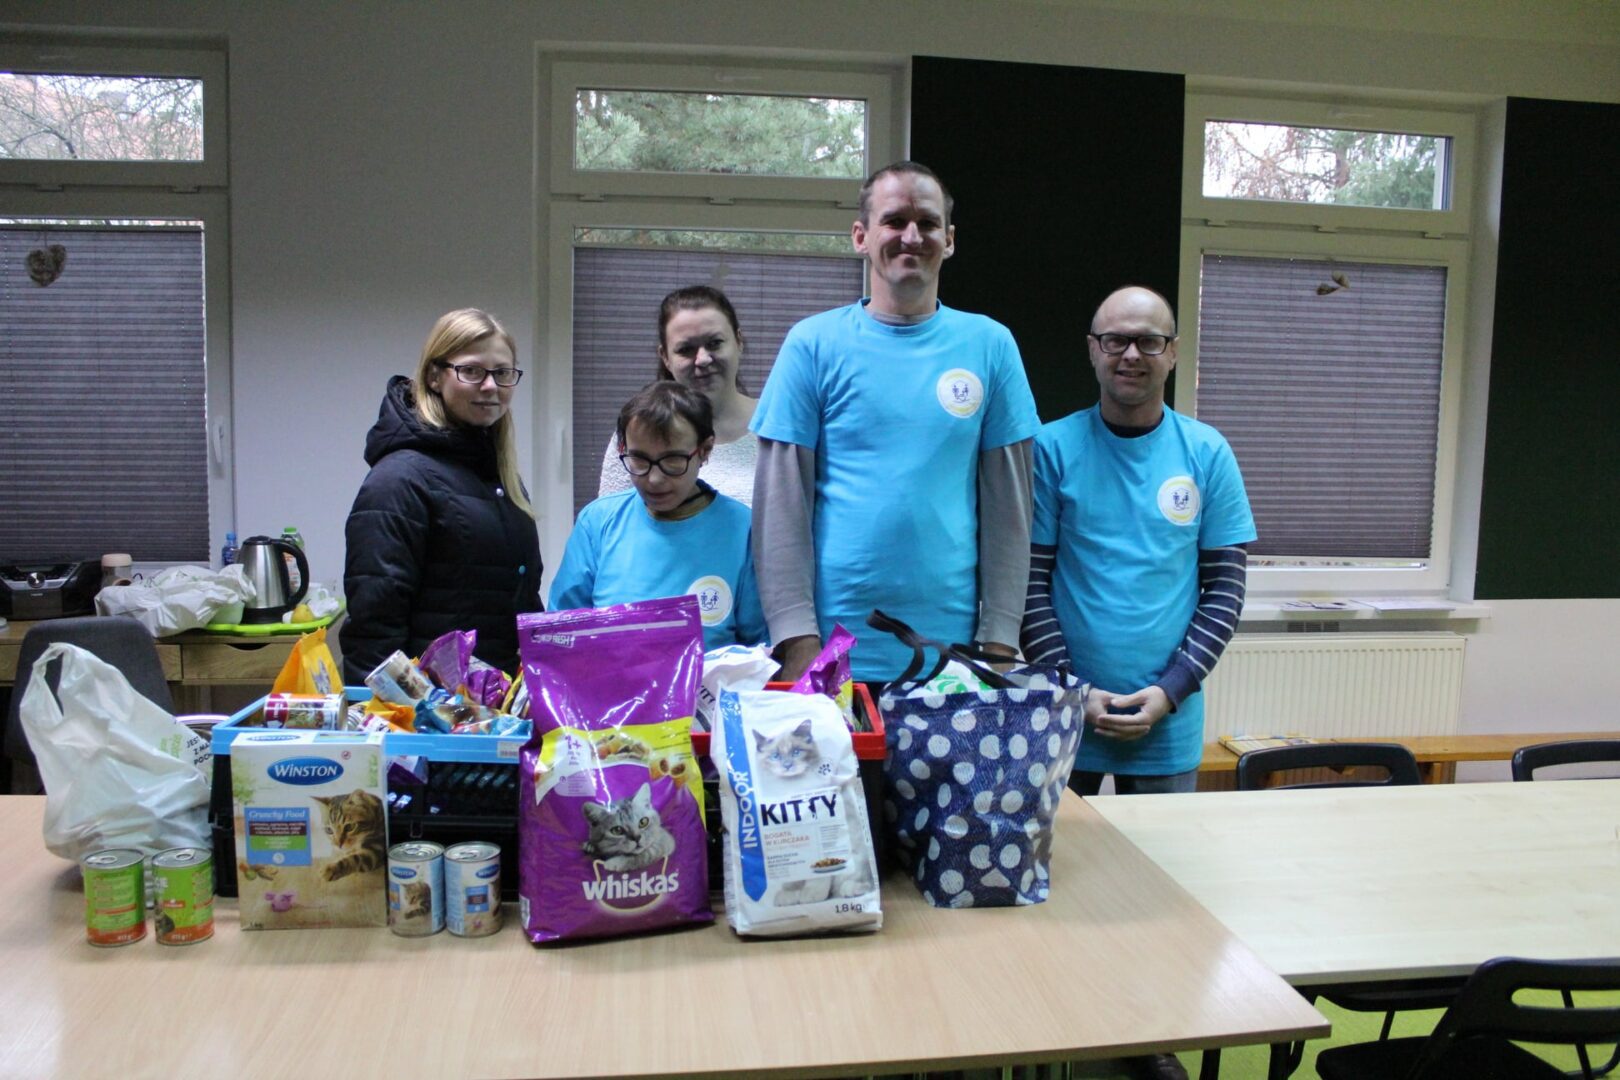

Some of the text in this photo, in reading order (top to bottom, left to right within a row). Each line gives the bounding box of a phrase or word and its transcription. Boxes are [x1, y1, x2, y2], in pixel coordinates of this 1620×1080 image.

[274, 763, 338, 778] WINSTON
[733, 771, 758, 848] INDOOR
[760, 793, 836, 827] KITTY
[582, 871, 680, 901] whiskas
[850, 902, 863, 913] kg
